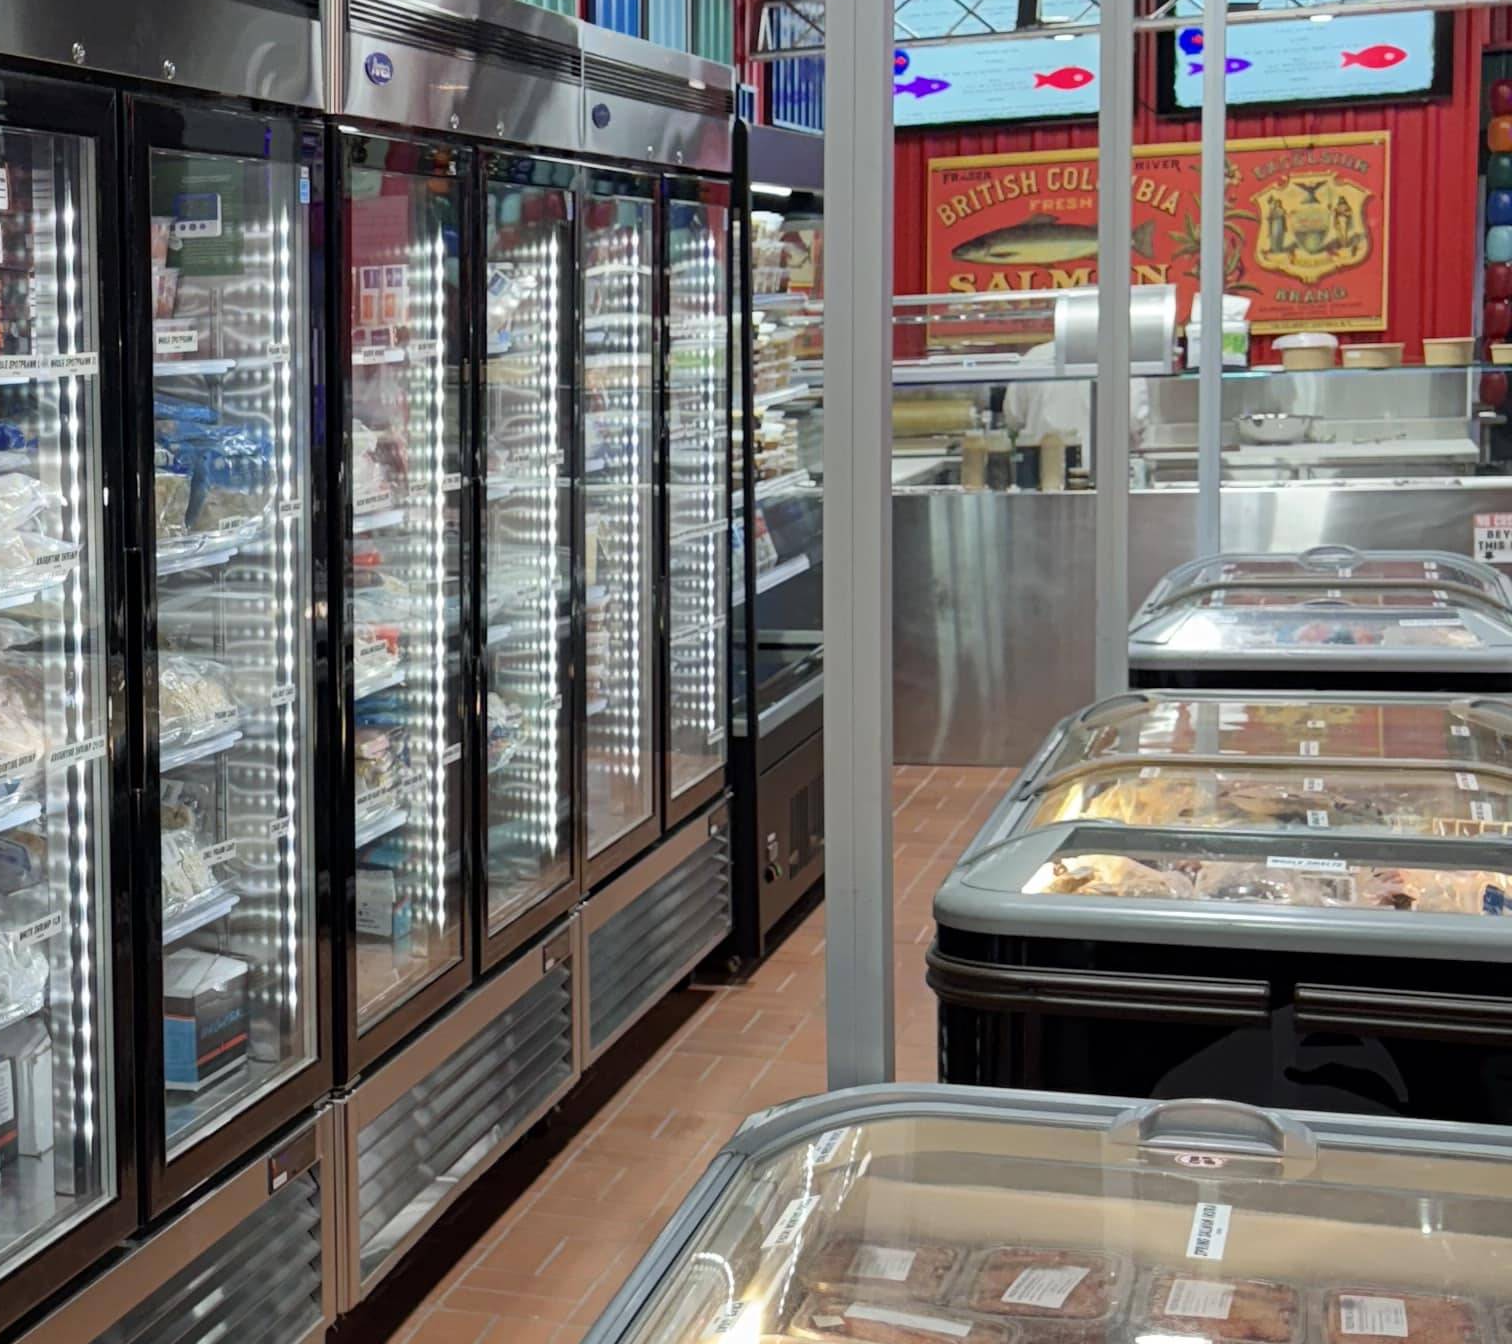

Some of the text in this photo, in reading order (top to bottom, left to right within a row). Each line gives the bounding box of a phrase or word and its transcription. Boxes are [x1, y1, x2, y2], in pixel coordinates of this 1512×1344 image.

[935, 166, 1181, 227] BRITISH COLBIA
[1029, 196, 1093, 212] FRESH
[948, 263, 1171, 304] SALMN
[1479, 541, 1505, 551] THIS
